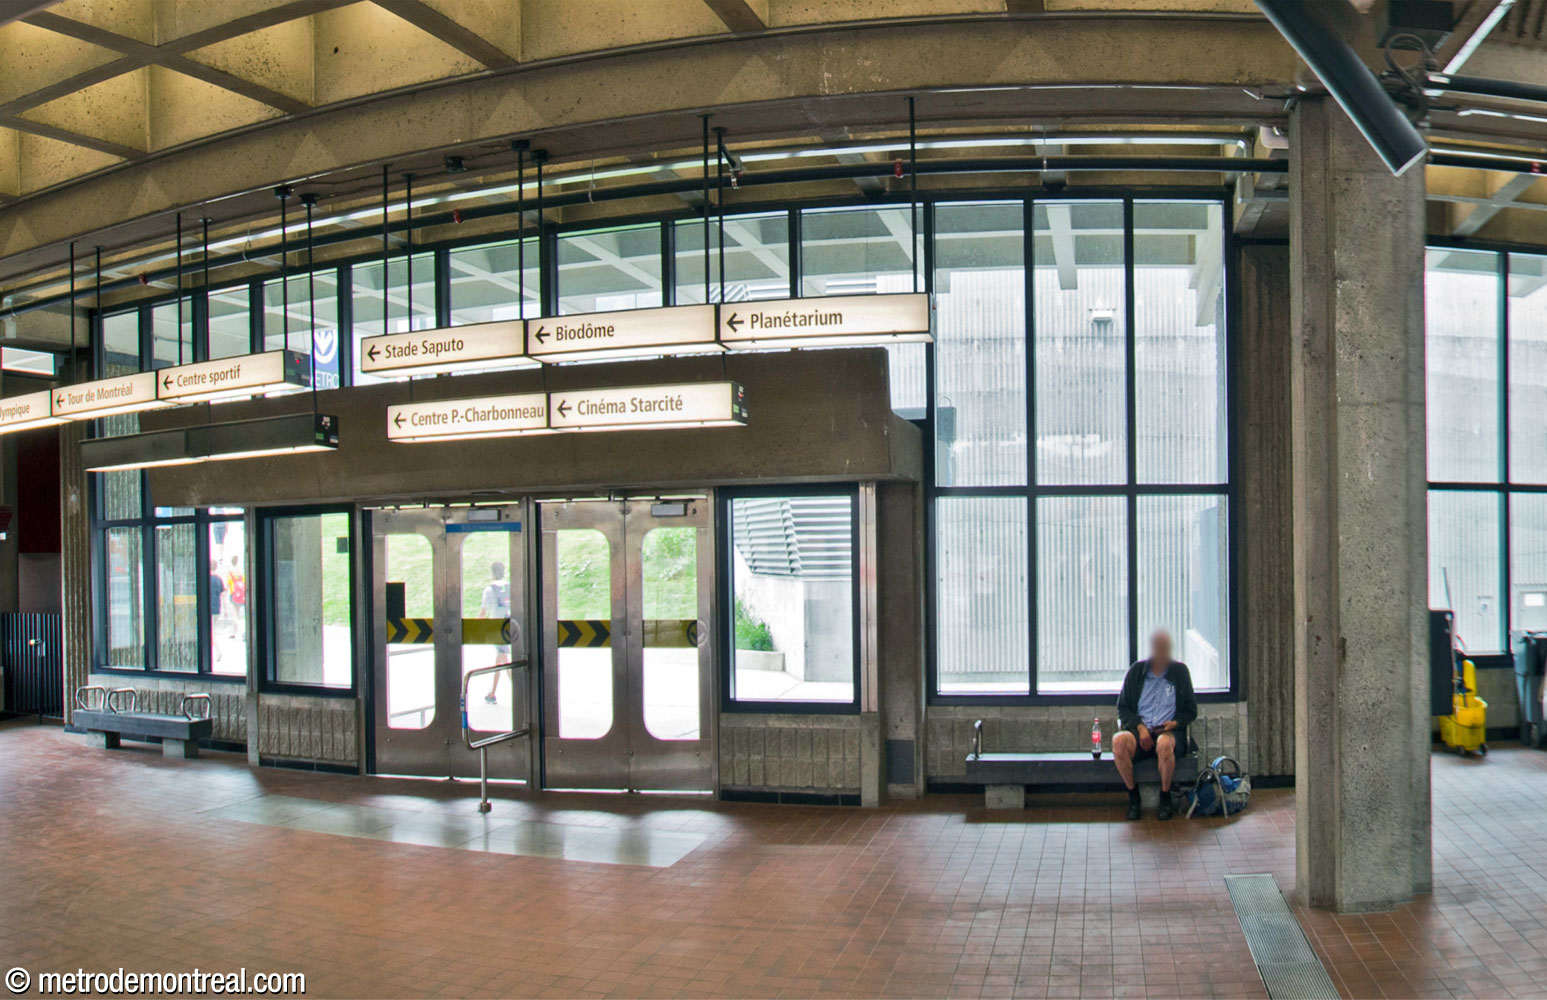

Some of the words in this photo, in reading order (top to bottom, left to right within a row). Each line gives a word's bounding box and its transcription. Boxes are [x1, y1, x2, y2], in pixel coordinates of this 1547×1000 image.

[556, 322, 615, 342] Biodôme
[750, 309, 844, 332] Planétarium
[385, 343, 418, 359] Stade
[422, 336, 464, 357] Saputo
[177, 373, 207, 389] Centre
[209, 364, 241, 386] sportif
[68, 392, 84, 406] Tour
[86, 390, 95, 403] de
[97, 383, 133, 401] Montréal
[577, 398, 626, 416] Cinéma
[630, 394, 683, 413] Starcité
[411, 412, 448, 426] Centre
[451, 406, 544, 424] P.-Charbonneau
